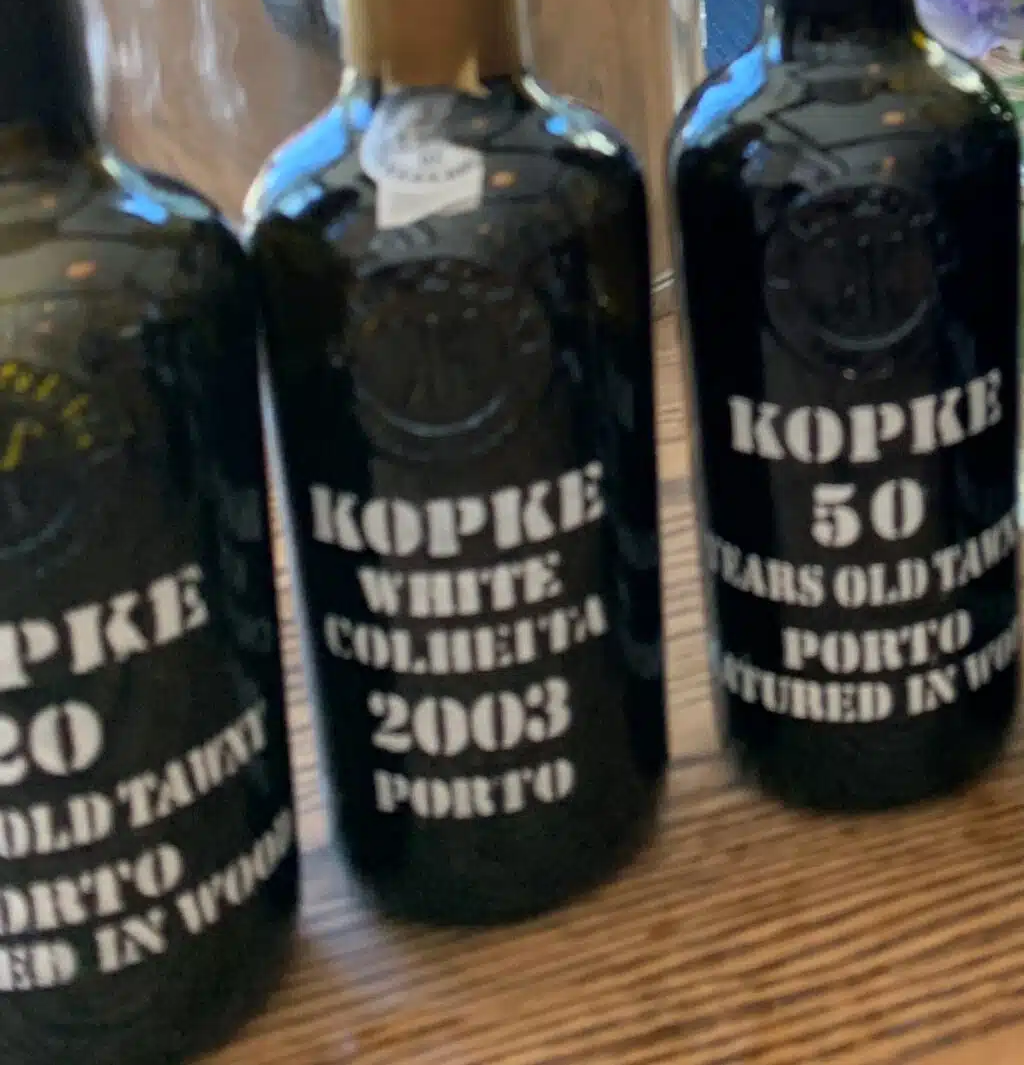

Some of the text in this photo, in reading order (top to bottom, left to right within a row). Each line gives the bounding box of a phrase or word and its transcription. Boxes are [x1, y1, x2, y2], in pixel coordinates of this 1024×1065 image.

[729, 368, 1002, 464] KOPKE
[310, 462, 604, 558] KOPKE
[811, 477, 925, 548] 50
[358, 551, 563, 619] WHITE
[833, 556, 929, 609] OLD
[324, 594, 610, 675] COLHEITA
[782, 609, 972, 674] PORTO
[367, 677, 571, 758] 2003
[905, 664, 957, 717] IN
[374, 758, 575, 819] PORTO
[95, 906, 168, 973] IN
